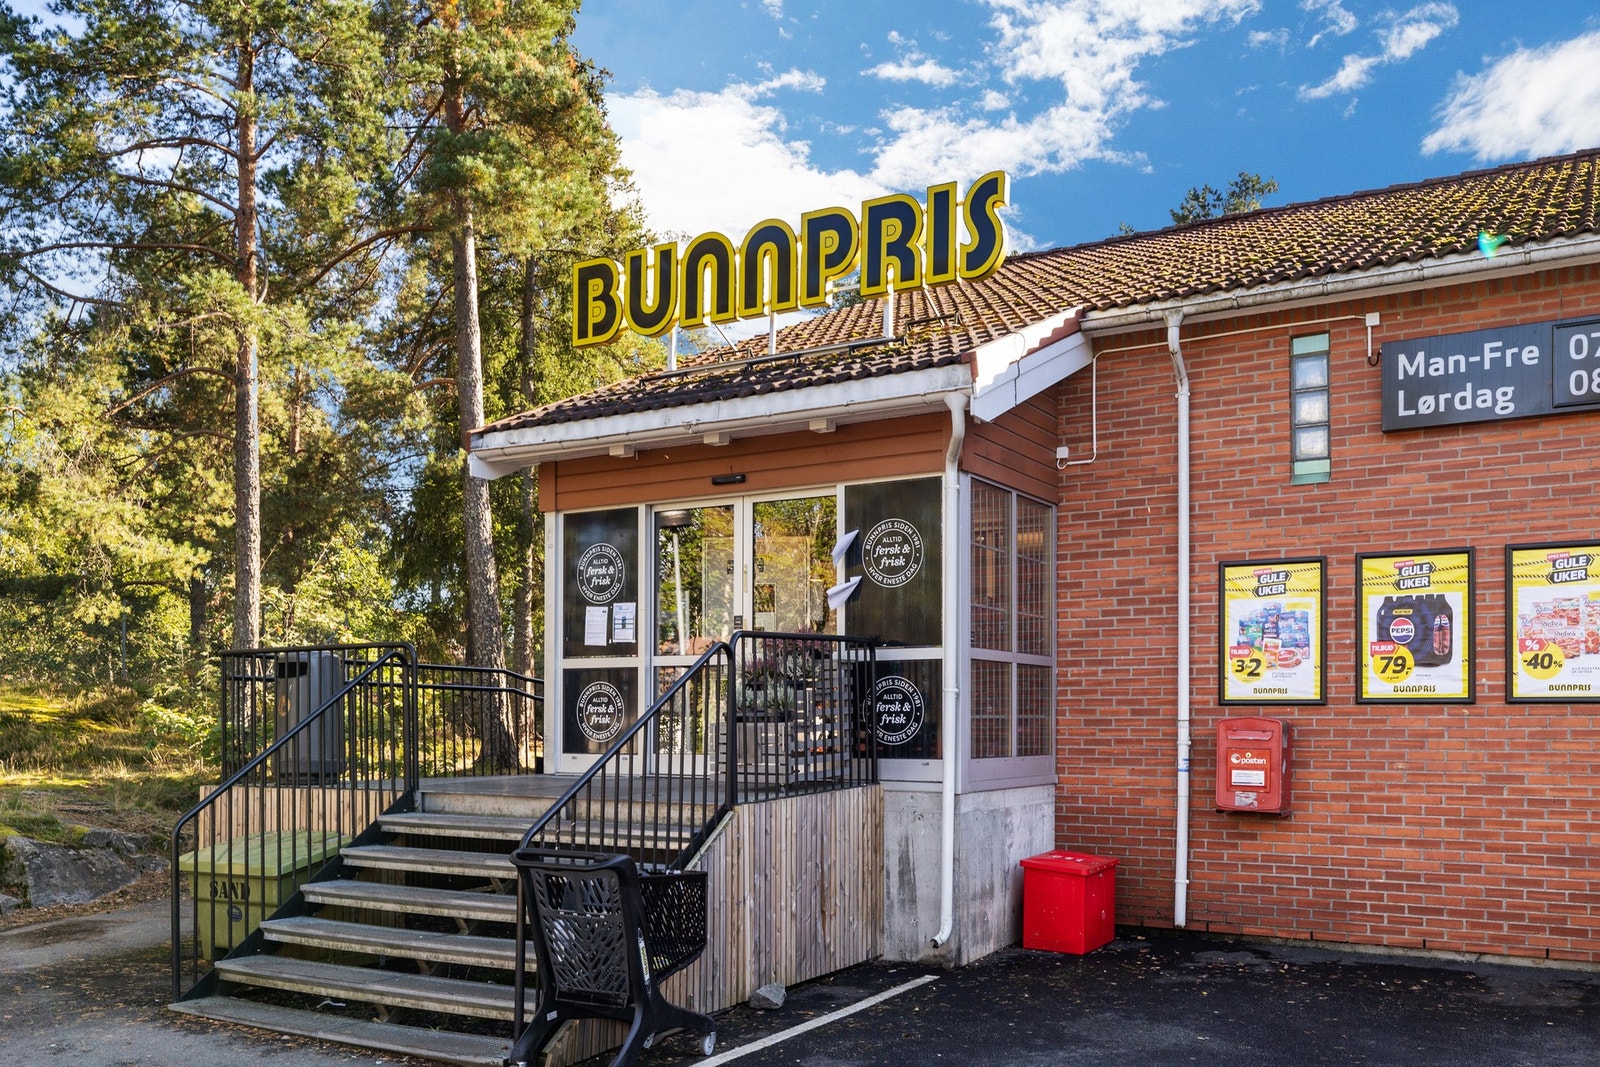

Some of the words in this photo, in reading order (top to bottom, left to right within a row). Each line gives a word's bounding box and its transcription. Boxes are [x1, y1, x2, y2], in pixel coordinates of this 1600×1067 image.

[573, 171, 1009, 348] BUNNPRIS
[1398, 341, 1540, 380] Man-Fre
[1398, 383, 1515, 416] Lørdag
[866, 522, 892, 550] BUNNPRIS
[894, 522, 914, 534] SIDEN
[874, 544, 900, 558] fersk
[902, 544, 911, 554] &
[879, 556, 906, 569] frisk
[1555, 556, 1587, 569] GULE
[586, 565, 607, 577] fersk
[608, 566, 615, 574] &
[868, 567, 883, 582] HVER
[883, 576, 906, 584] ENESTE
[906, 563, 918, 577] DAG
[1401, 564, 1430, 576] GULE
[1553, 570, 1586, 582] UKER
[590, 576, 611, 588] frisk
[1260, 572, 1286, 583] GULE
[1400, 577, 1429, 589] UKER
[1258, 584, 1284, 596] UKER
[1525, 640, 1540, 650] %
[1235, 660, 1245, 673] 3
[1247, 658, 1261, 677] 2
[1379, 656, 1412, 675] 79,-
[1523, 653, 1562, 670] -40%
[894, 680, 914, 693] SIDEN
[586, 704, 607, 714] fersk
[607, 704, 614, 713] &
[876, 701, 901, 712] fersk
[902, 702, 911, 712] &
[590, 715, 610, 726] frisk
[880, 714, 906, 726] frisk
[884, 732, 907, 742] ENESTE
[906, 722, 918, 735] DAG
